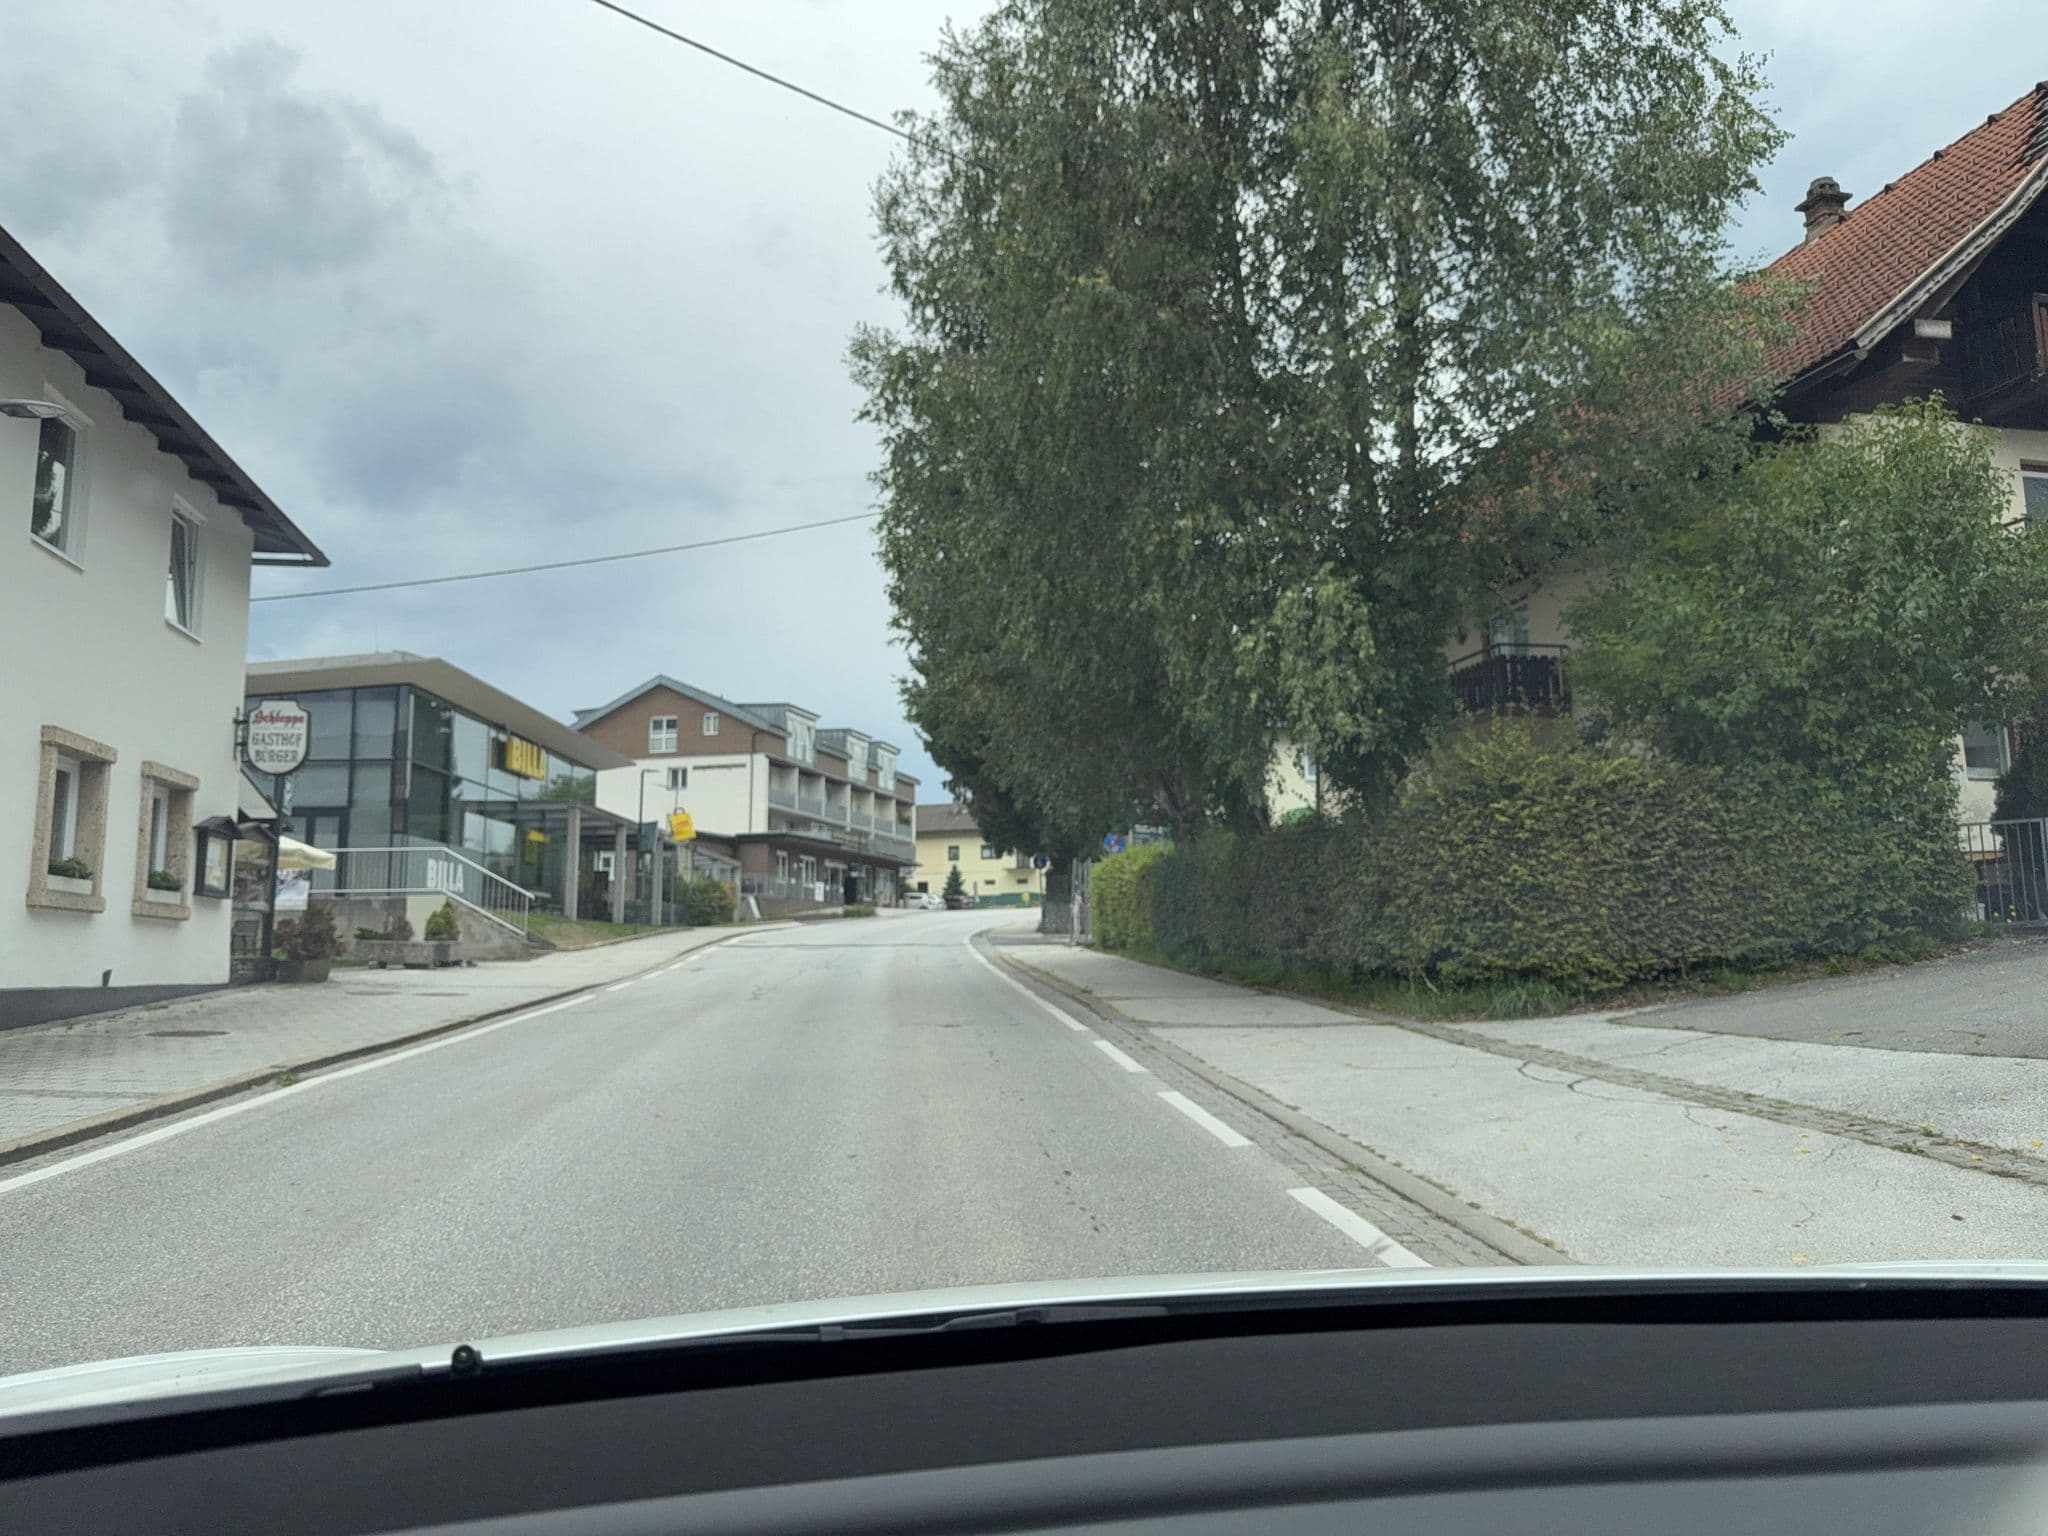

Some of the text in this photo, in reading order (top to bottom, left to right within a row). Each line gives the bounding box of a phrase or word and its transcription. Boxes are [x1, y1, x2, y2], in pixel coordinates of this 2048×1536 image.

[251, 732, 303, 747] GASTHOF
[511, 736, 546, 780] BILLA
[426, 858, 464, 893] BILLA
